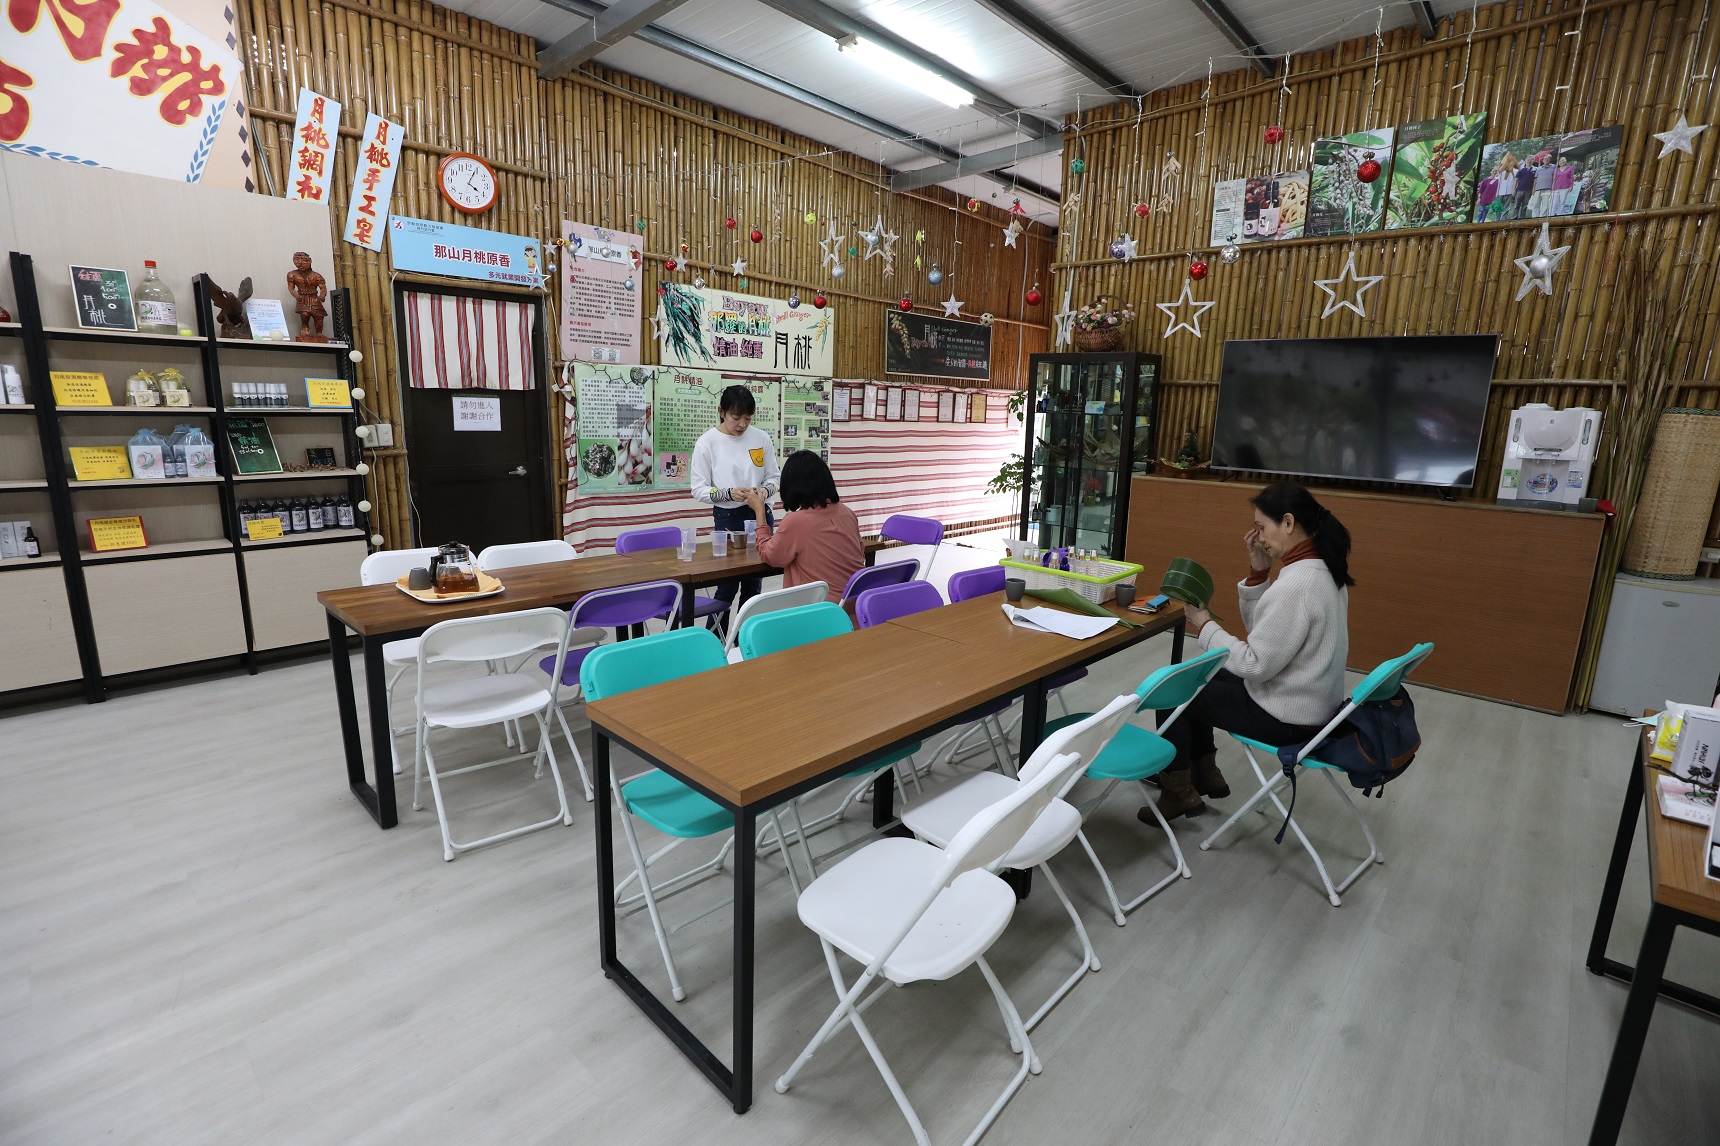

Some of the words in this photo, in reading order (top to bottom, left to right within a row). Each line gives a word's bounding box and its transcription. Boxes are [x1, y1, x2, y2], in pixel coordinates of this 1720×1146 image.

[291, 96, 331, 201] 月桃調和
[353, 120, 392, 246] 月桃手工皂
[433, 244, 511, 269] 那山月桃原香
[789, 309, 812, 322] Ginger
[713, 335, 739, 358] 精油
[740, 337, 764, 359] 純露
[773, 330, 813, 370] 月桃
[674, 375, 704, 386] 月桃精油
[460, 400, 494, 410] 請勿進入
[460, 411, 494, 421] 謝謝合作
